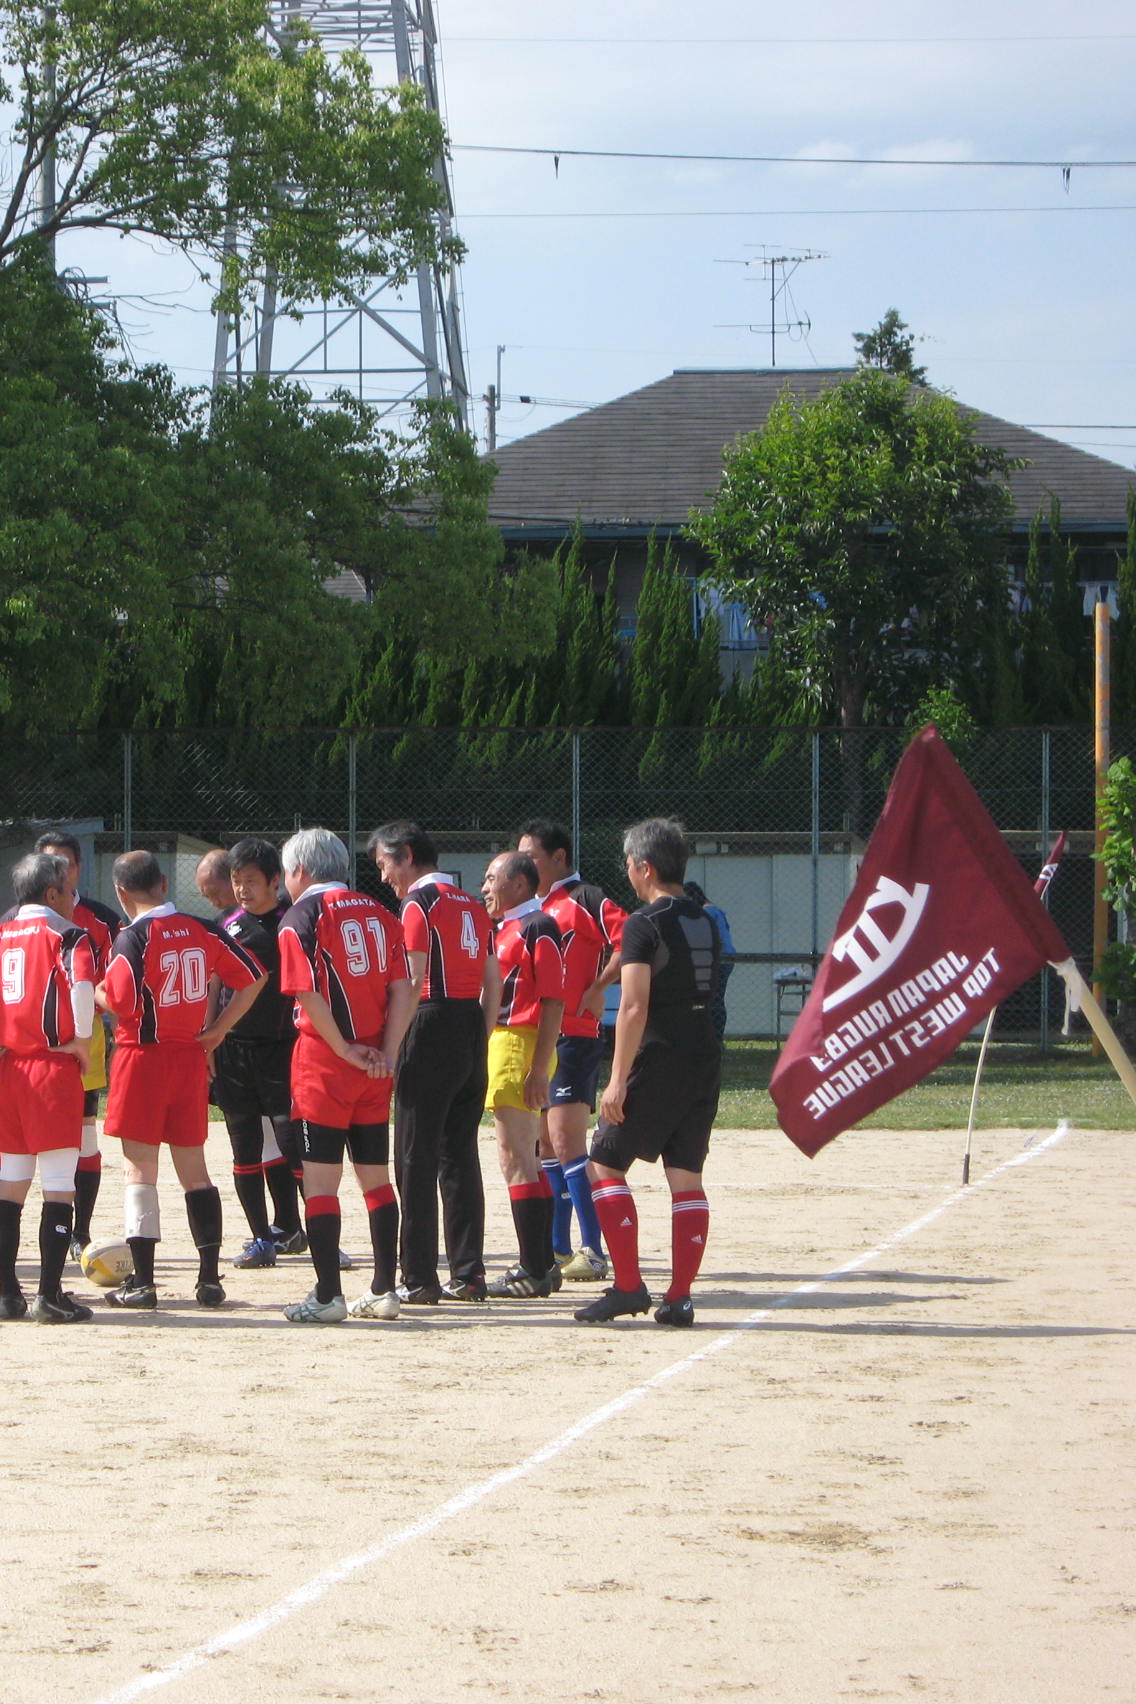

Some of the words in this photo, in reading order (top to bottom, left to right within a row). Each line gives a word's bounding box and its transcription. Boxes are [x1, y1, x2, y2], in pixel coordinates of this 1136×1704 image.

[340, 917, 388, 977] 91
[461, 911, 480, 959] 4
[1, 947, 25, 1005] 9
[158, 947, 208, 1008] 20
